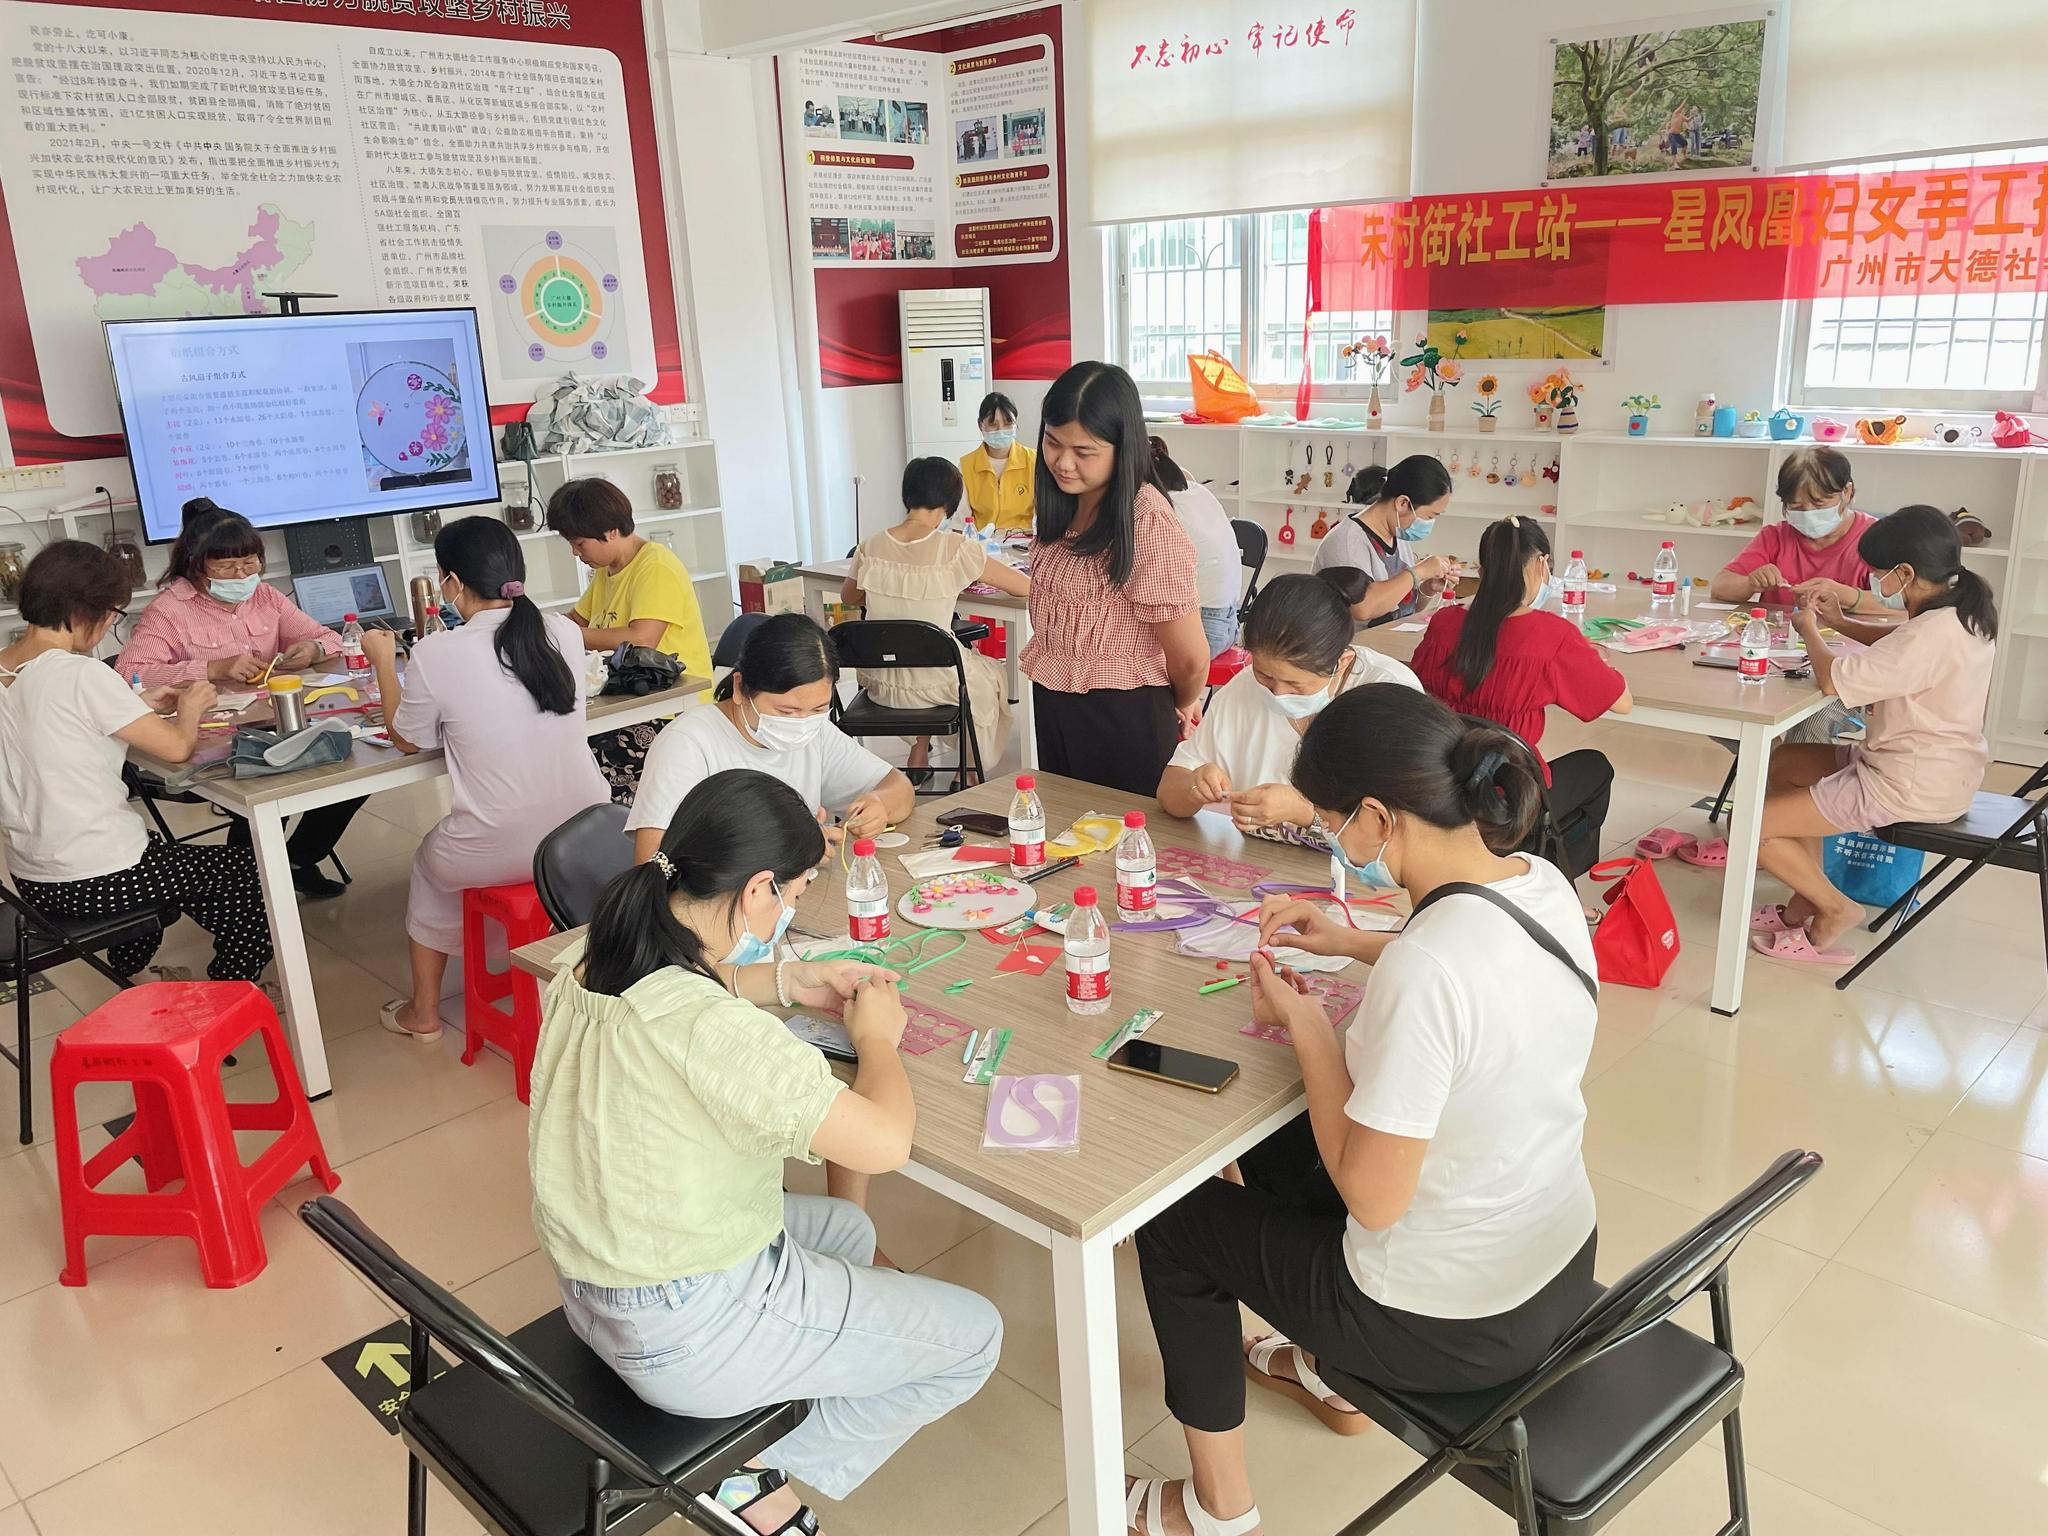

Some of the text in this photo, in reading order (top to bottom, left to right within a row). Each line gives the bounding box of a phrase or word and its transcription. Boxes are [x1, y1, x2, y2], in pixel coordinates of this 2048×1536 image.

[1130, 8, 1357, 70] 不忘初心 牢记使命
[1821, 247, 2048, 288] 广州市大德社
